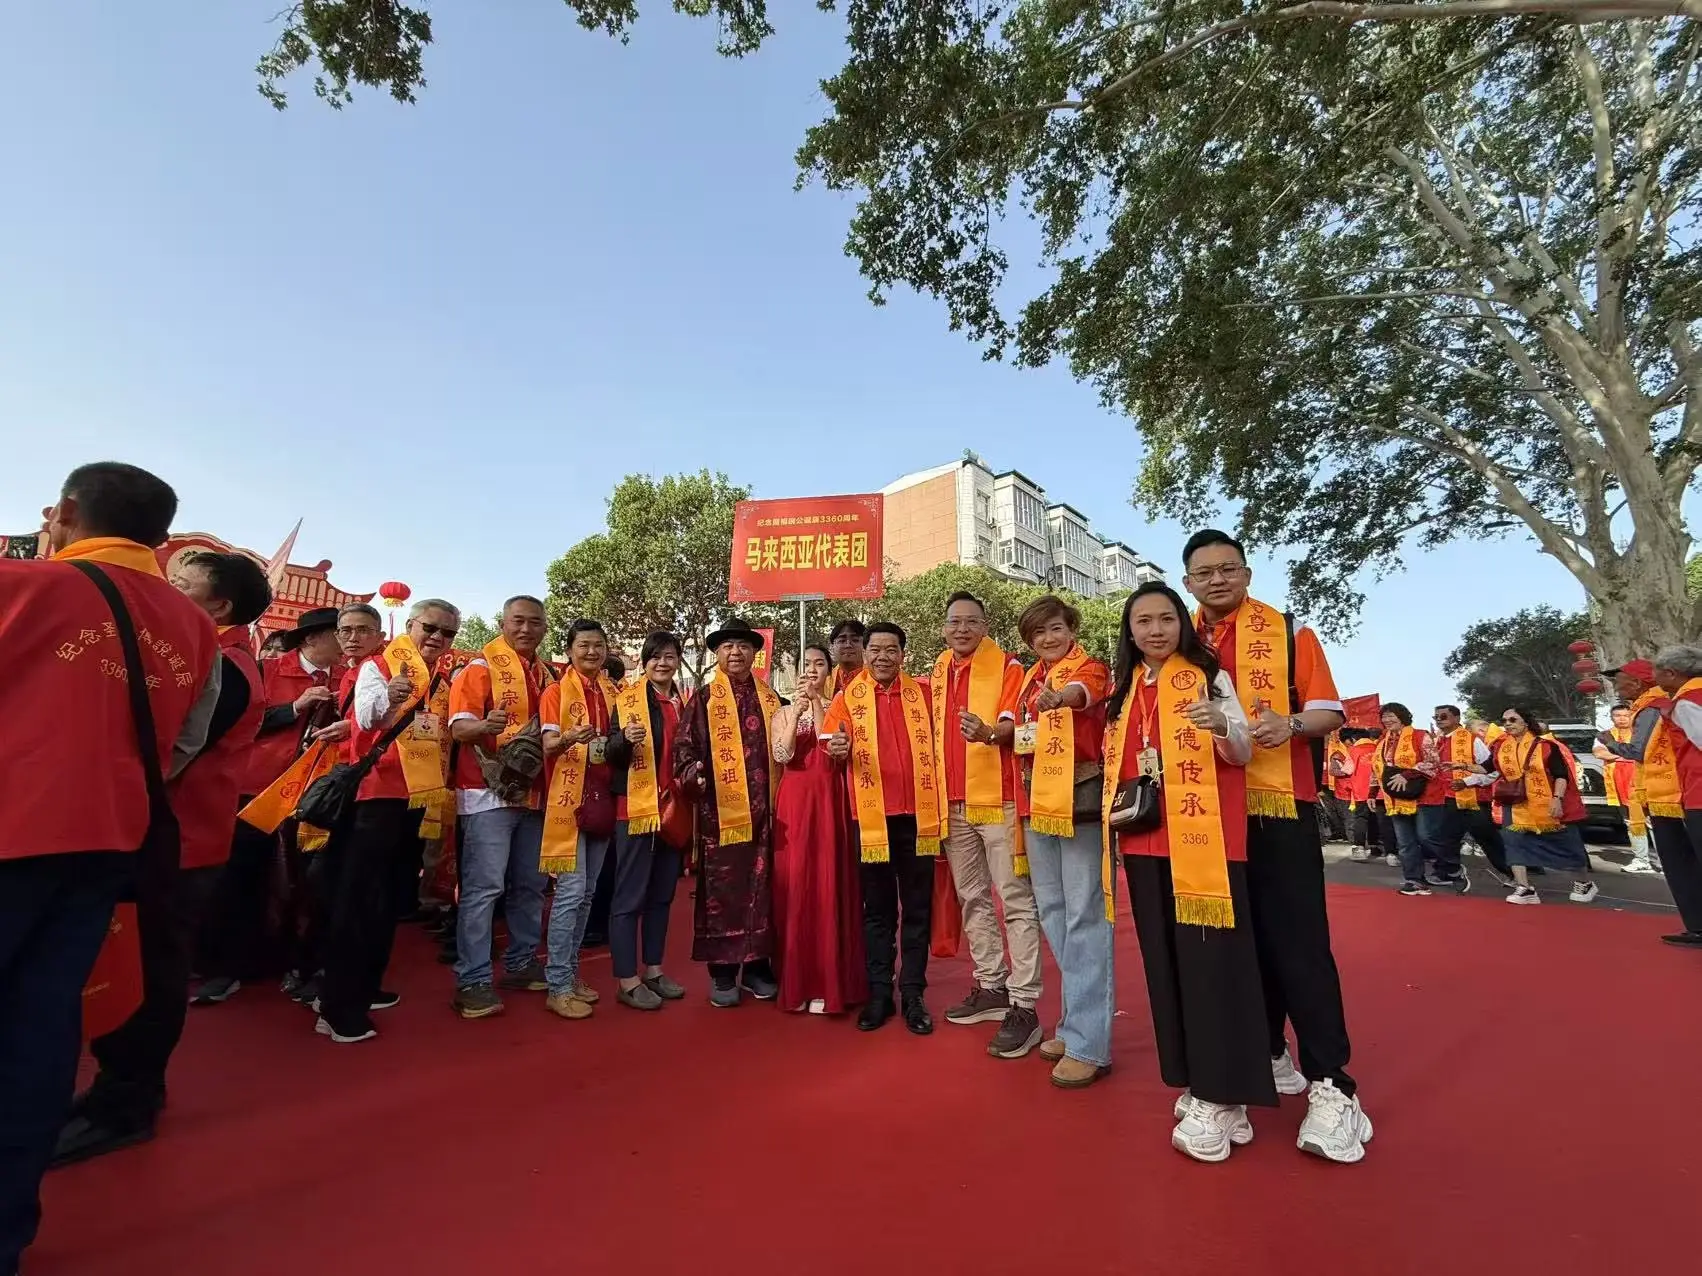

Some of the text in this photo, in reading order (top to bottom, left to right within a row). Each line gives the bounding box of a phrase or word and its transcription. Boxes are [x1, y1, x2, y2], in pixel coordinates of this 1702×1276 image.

[745, 532, 868, 572] 马来西亚代表团
[100, 658, 162, 690] 3360年
[499, 671, 520, 740] 尊宗敬
[624, 693, 647, 772] 尊祖
[410, 749, 429, 760] 3360
[715, 705, 739, 785] 尊宗敬祖
[852, 704, 875, 790] 孝德传承
[911, 708, 933, 791] 尊宗敬祖
[1042, 766, 1063, 776] 3360
[1182, 833, 1208, 846] 3360
